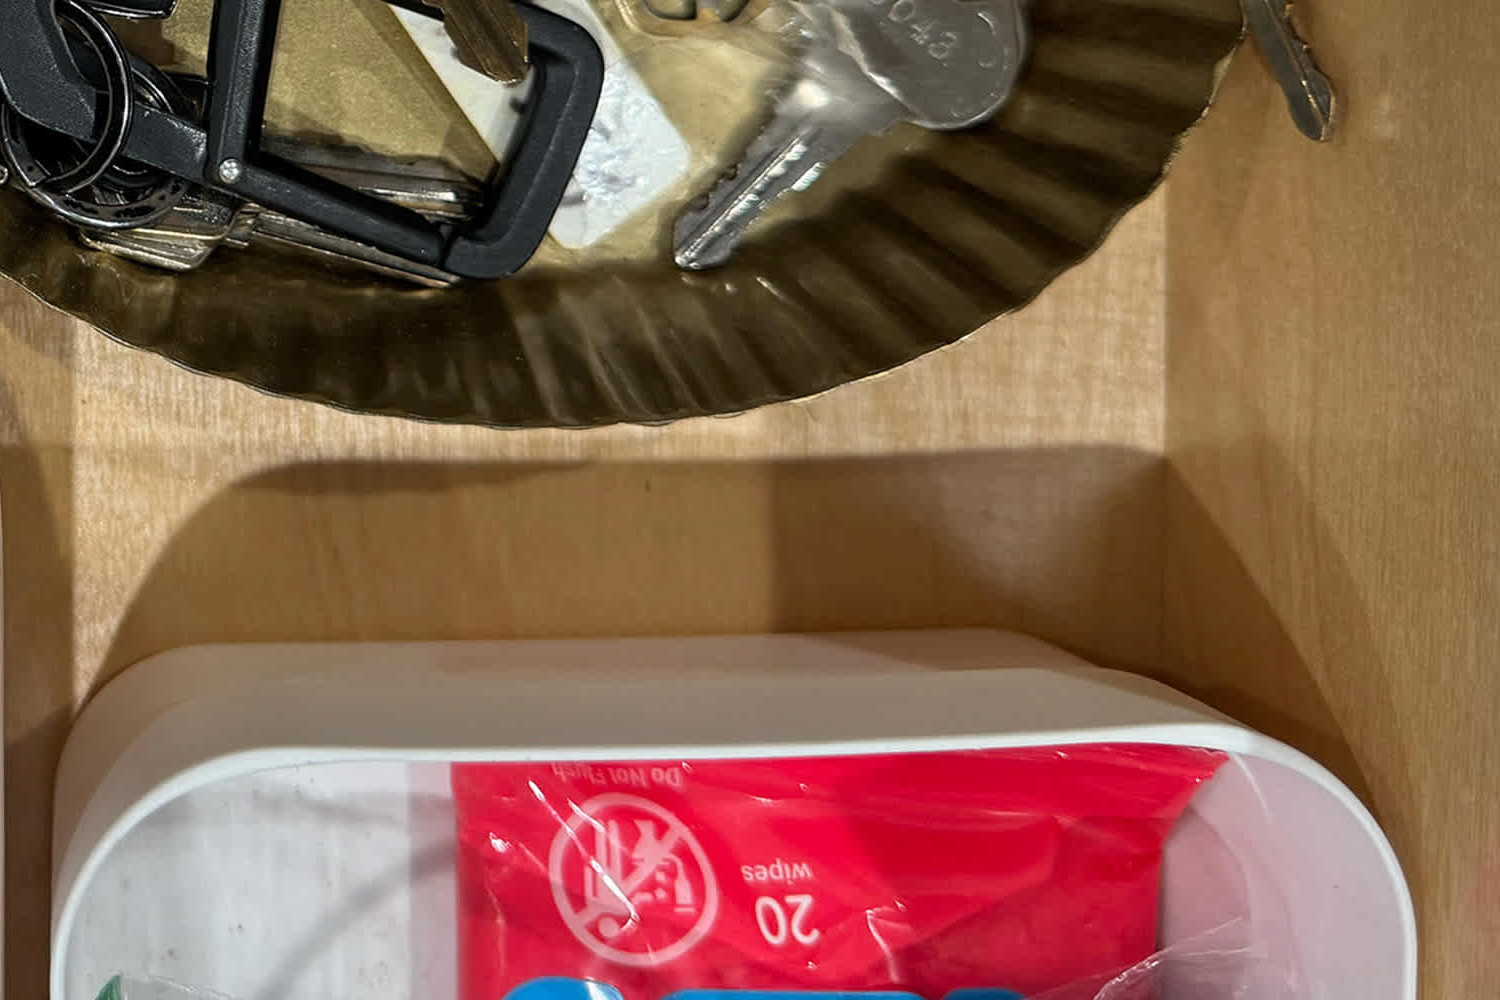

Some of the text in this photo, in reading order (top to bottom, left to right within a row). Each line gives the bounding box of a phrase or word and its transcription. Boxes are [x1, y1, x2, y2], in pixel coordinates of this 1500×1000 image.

[651, 766, 682, 788] Do
[741, 858, 812, 884] wipes
[755, 894, 820, 945] 20
